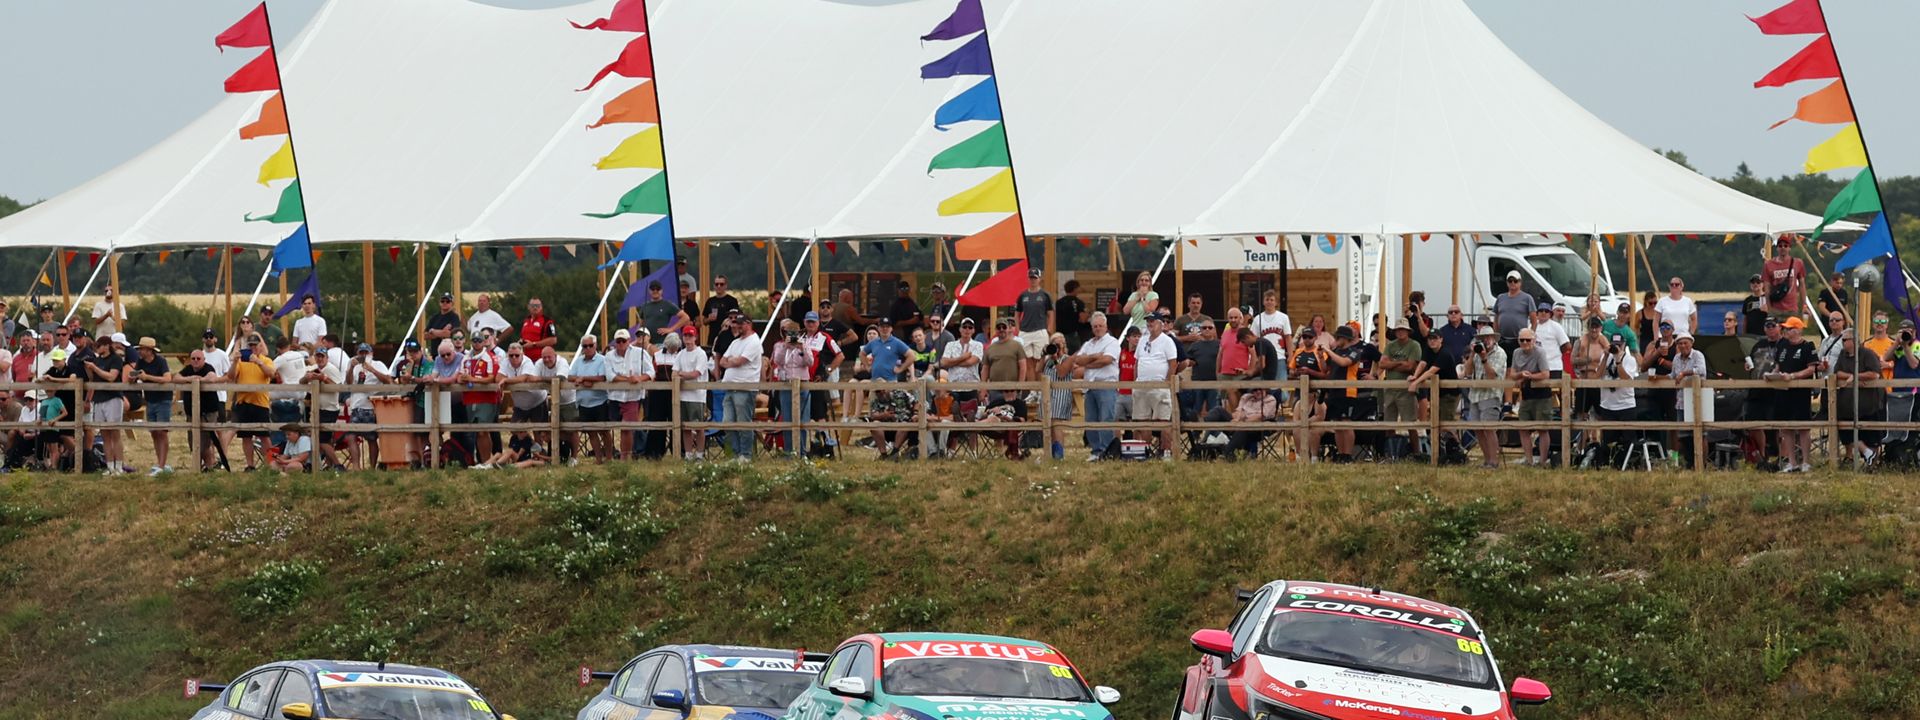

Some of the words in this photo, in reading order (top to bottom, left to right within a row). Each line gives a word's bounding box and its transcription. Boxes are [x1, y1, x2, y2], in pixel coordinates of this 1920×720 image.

[1244, 250, 1279, 262] Team
[1333, 589, 1463, 619] morson
[1289, 600, 1464, 633] COROLLA
[1457, 639, 1483, 655] 66
[1048, 665, 1073, 680] 80
[369, 674, 466, 689] Valvoline
[1266, 682, 1294, 698] Tracker
[1335, 699, 1401, 716] McKenzie
